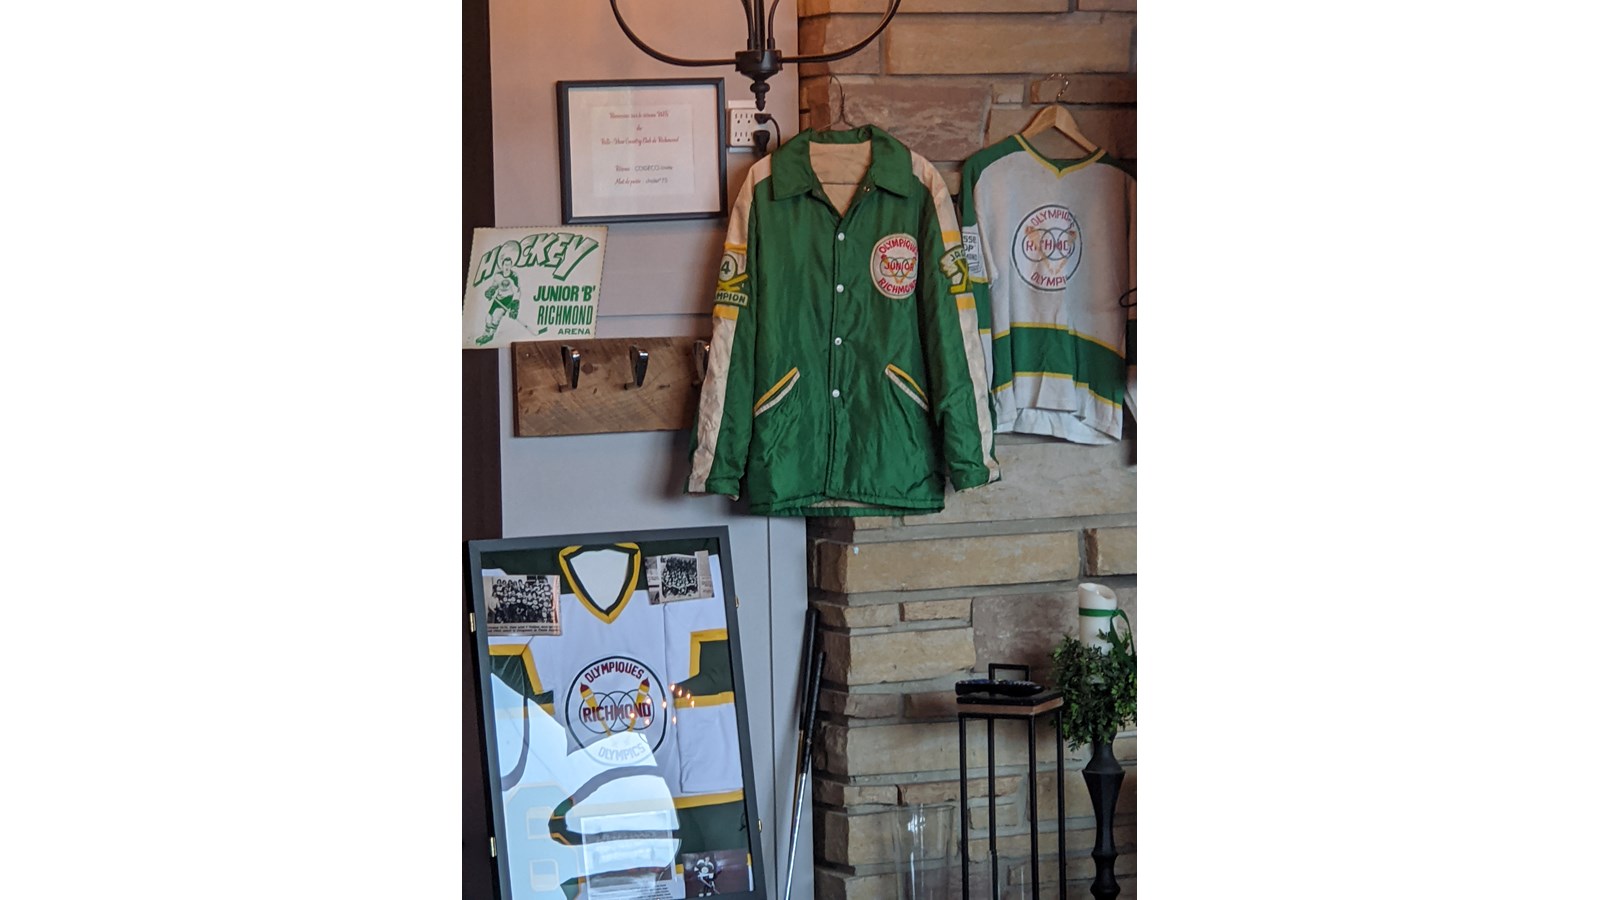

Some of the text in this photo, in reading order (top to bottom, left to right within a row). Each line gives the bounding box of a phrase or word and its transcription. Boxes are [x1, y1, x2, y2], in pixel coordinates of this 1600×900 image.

[473, 232, 599, 288] HOCKEY
[884, 262, 914, 271] JUNIOR
[533, 285, 579, 302] JUNIOR
[537, 305, 593, 325] RICHMOND
[584, 661, 644, 683] OLYMPIQUES
[582, 702, 651, 723] RICHMOND
[598, 742, 646, 761] OLYMPICS
